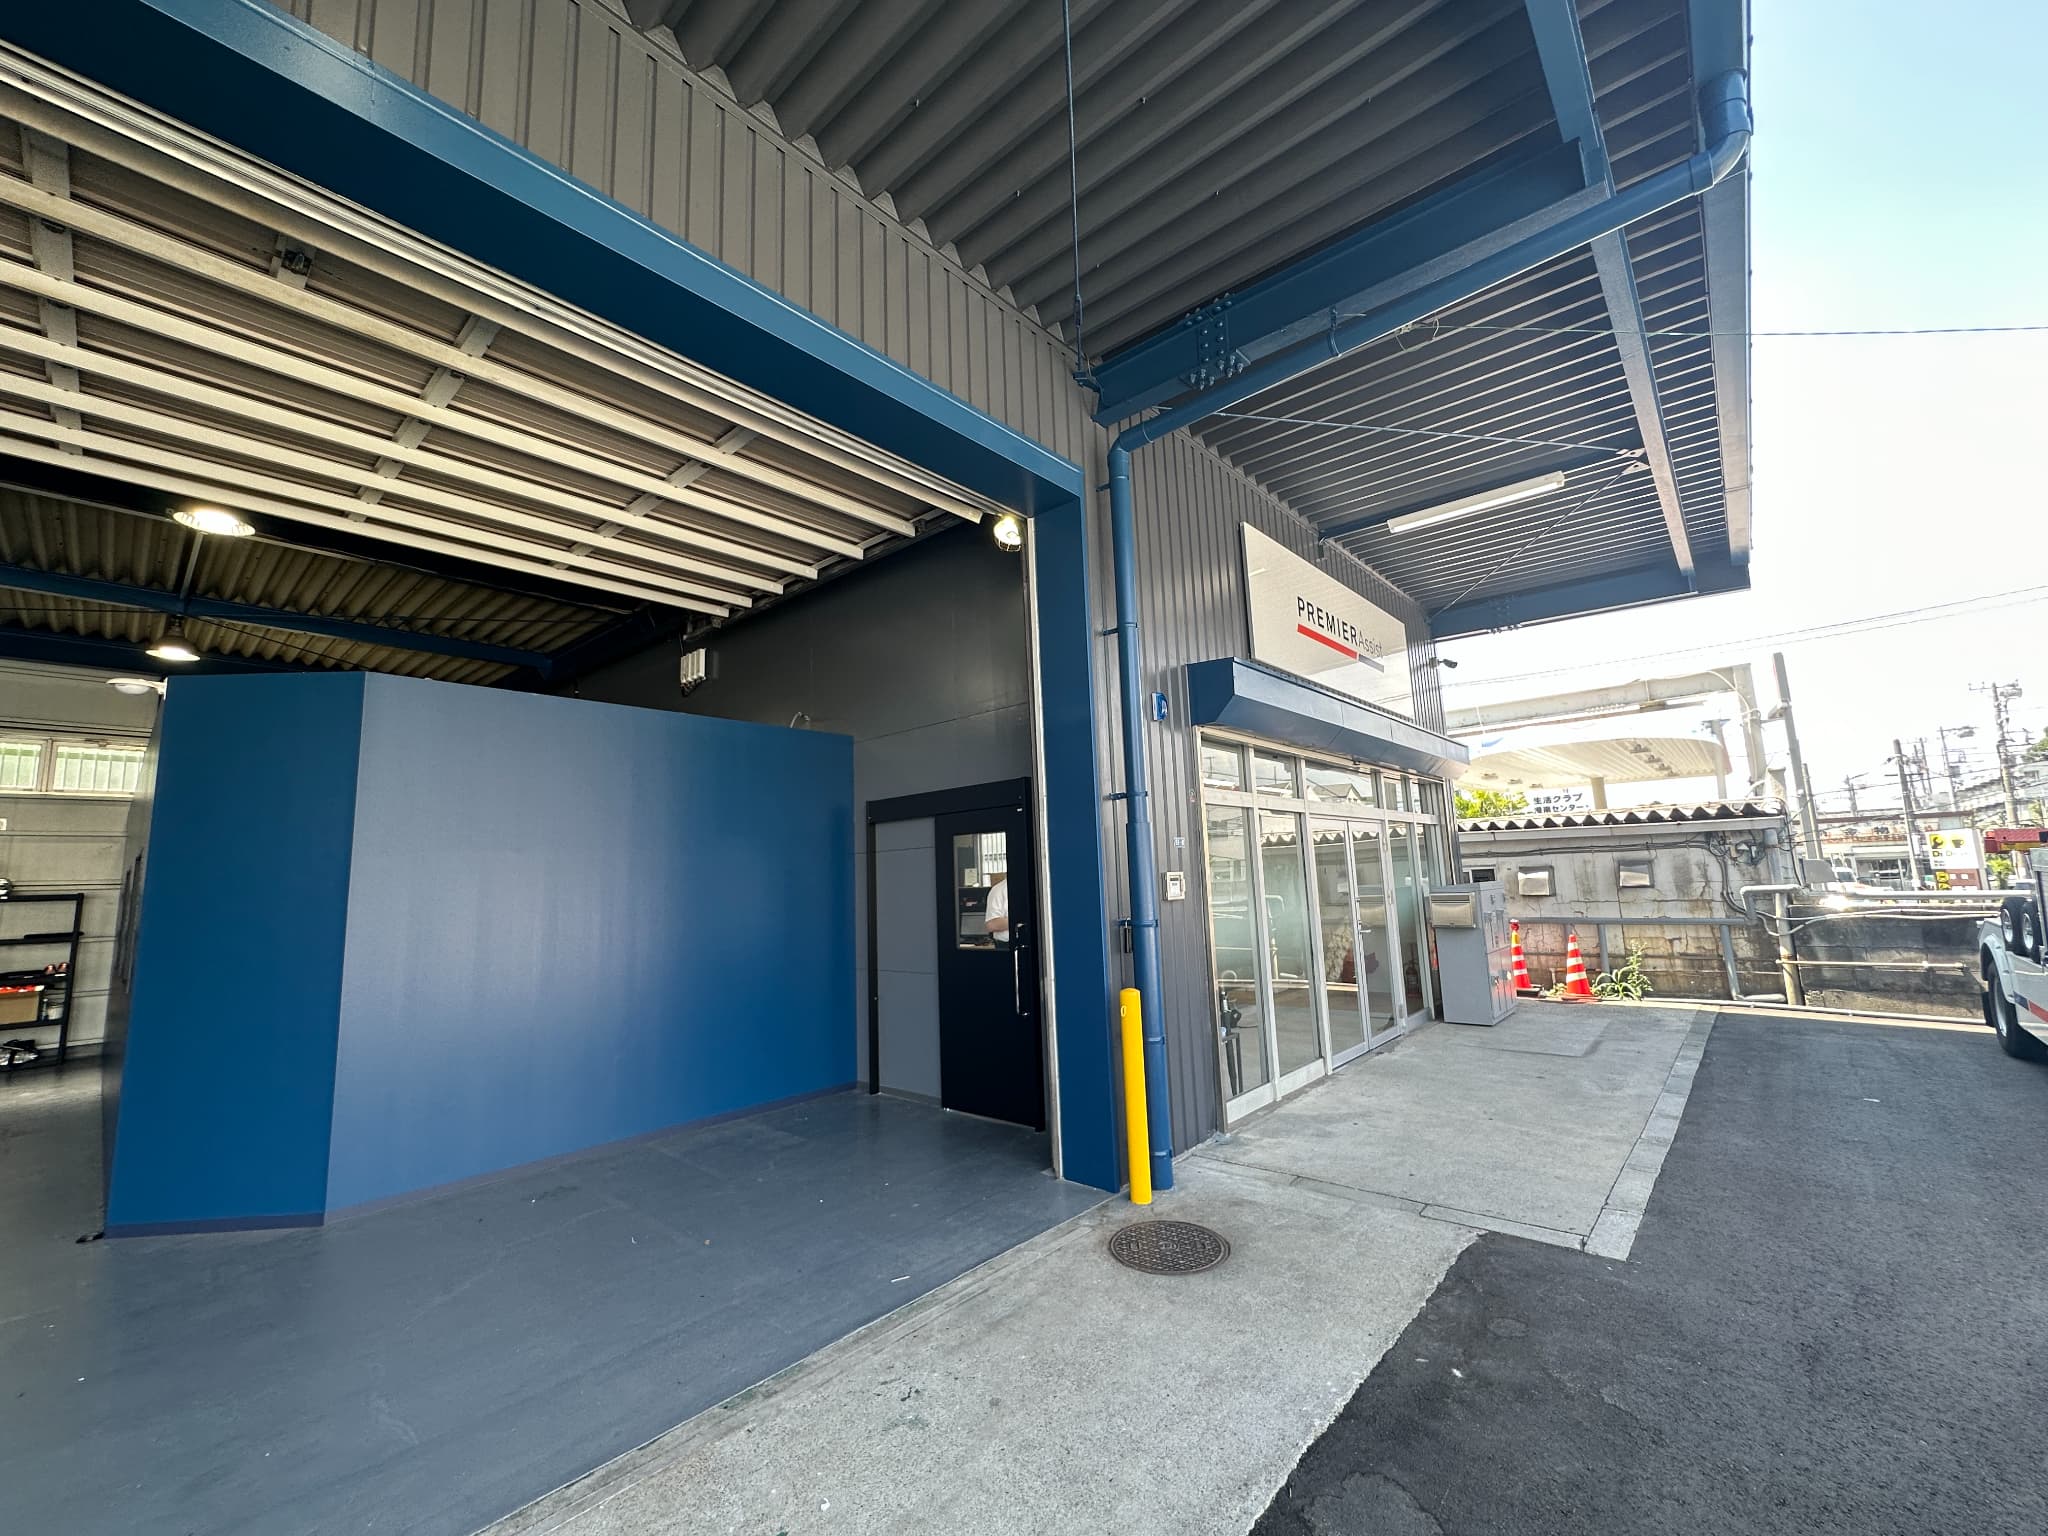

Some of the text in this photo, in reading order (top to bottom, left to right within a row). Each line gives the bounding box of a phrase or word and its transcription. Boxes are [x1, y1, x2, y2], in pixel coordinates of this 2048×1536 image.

[1534, 792, 1583, 804] 生活クラブ
